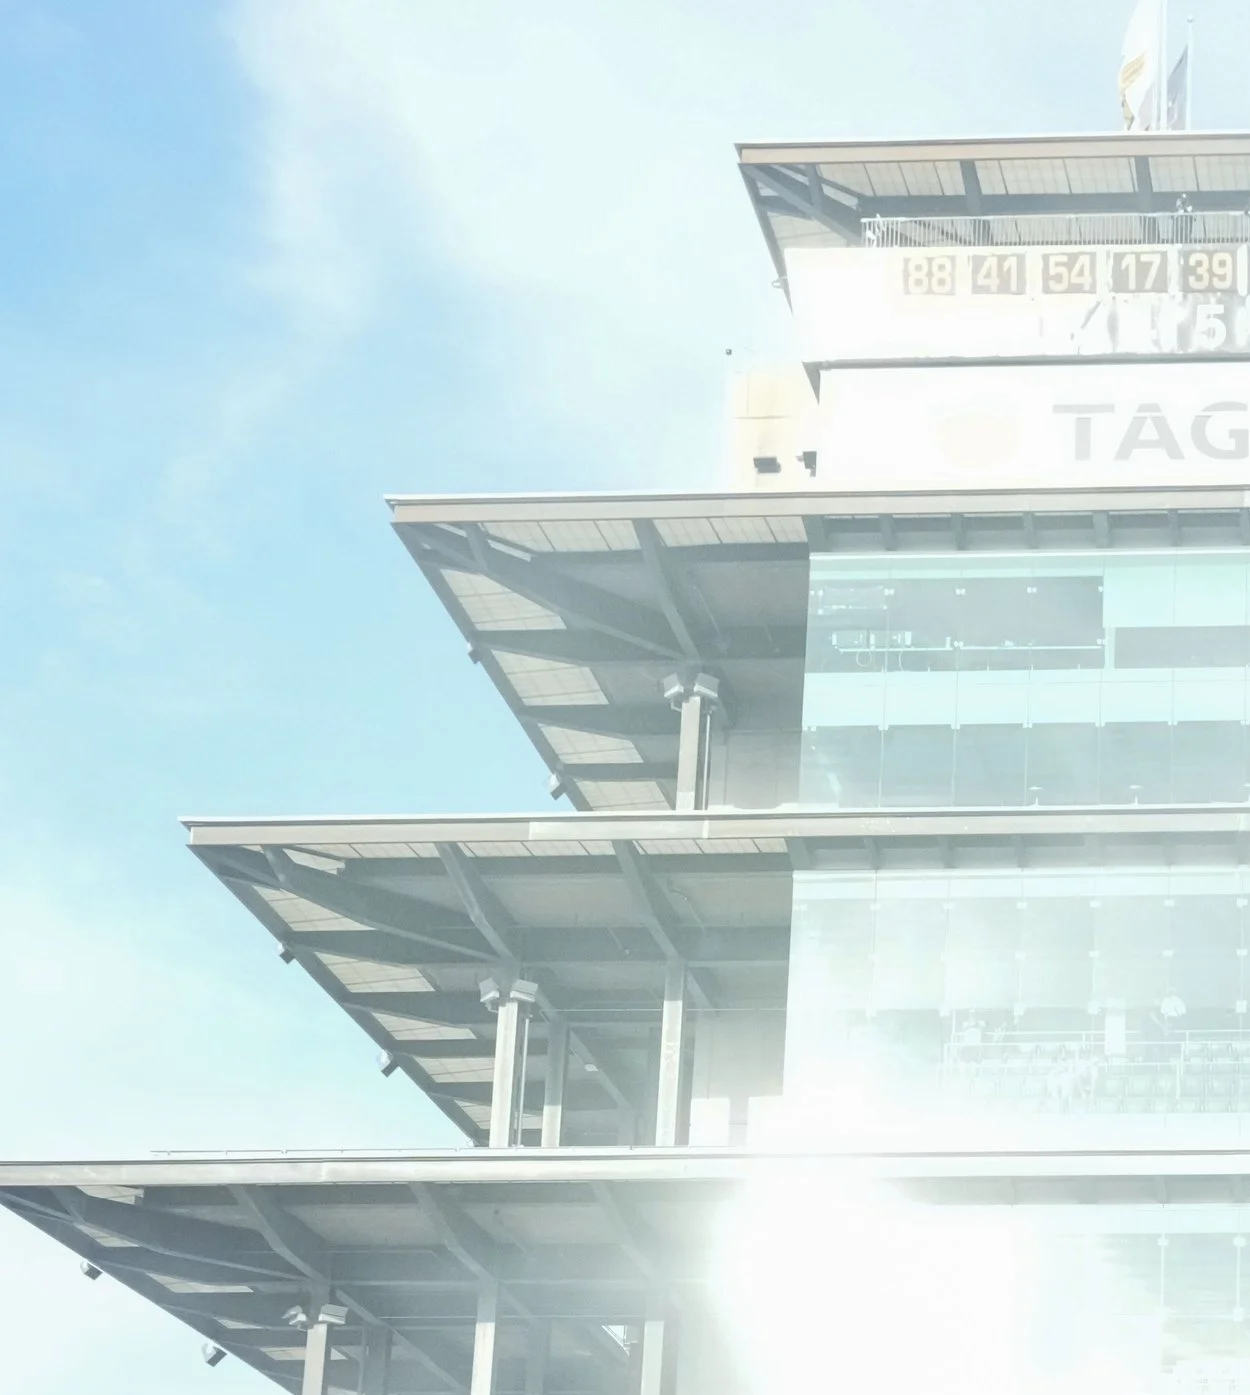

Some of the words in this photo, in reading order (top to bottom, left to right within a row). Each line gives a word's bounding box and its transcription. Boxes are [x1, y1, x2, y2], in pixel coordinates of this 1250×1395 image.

[908, 256, 952, 294] 88
[977, 254, 1018, 292] 41
[1049, 254, 1092, 291] 54
[1121, 253, 1162, 290] 17
[1188, 252, 1233, 290] 39
[1197, 303, 1227, 348] 5
